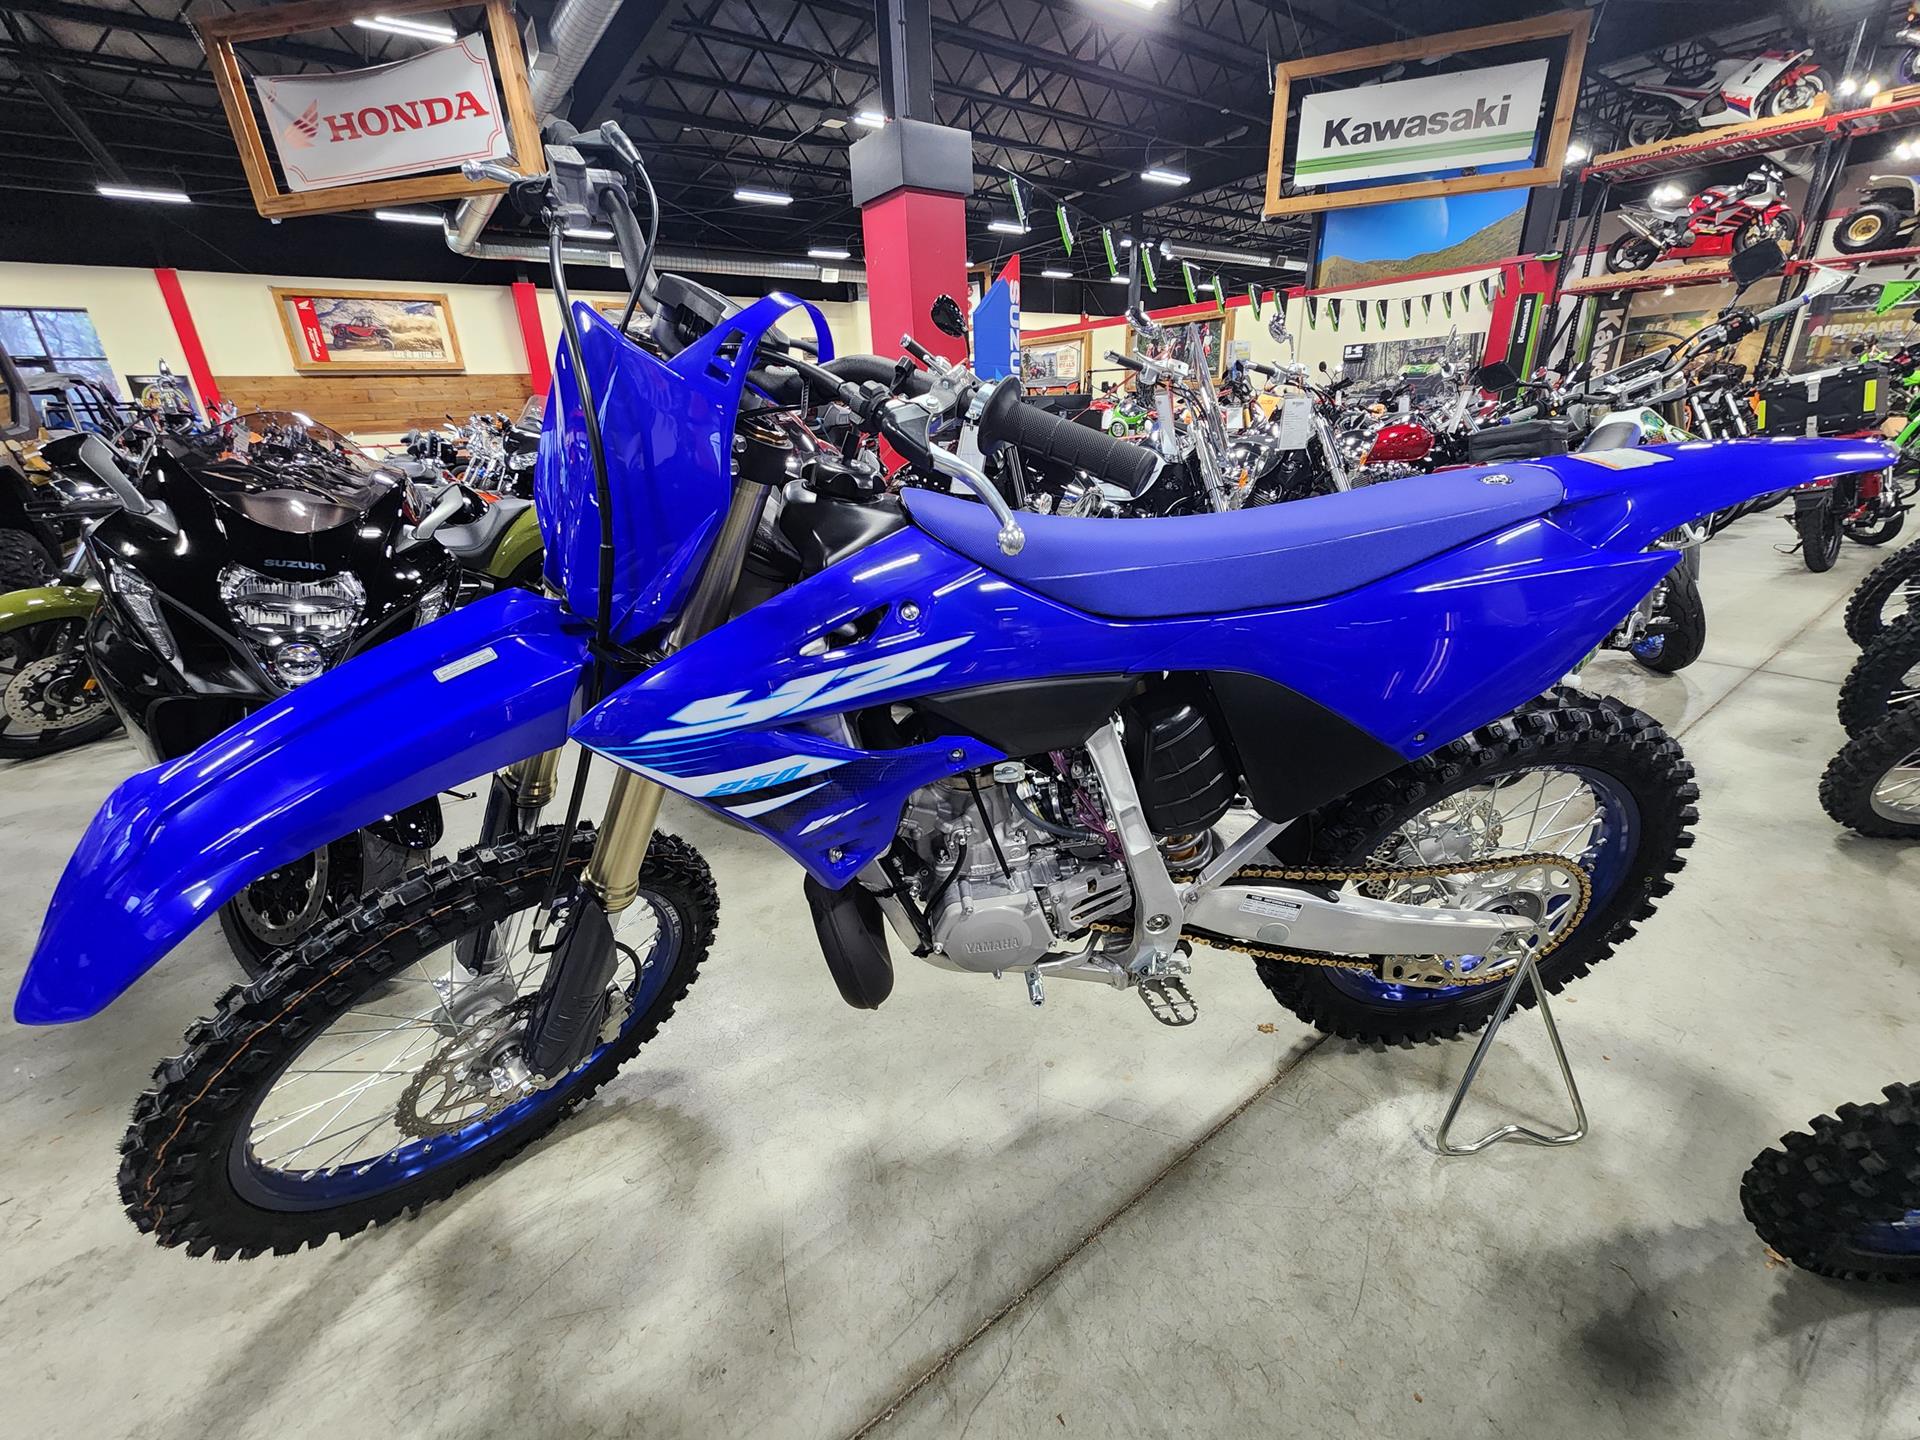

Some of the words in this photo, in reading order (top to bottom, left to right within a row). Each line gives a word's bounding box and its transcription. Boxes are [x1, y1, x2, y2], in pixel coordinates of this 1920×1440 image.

[323, 90, 490, 142] HONDA
[1323, 94, 1512, 148] Kawasaki
[1009, 280, 1020, 381] SUZU
[1517, 299, 1532, 343] Kawasaki
[264, 559, 326, 571] SUZUKI
[704, 763, 810, 797] 250
[665, 905, 680, 924] EXCEL
[965, 937, 1020, 954] YAMAHA
